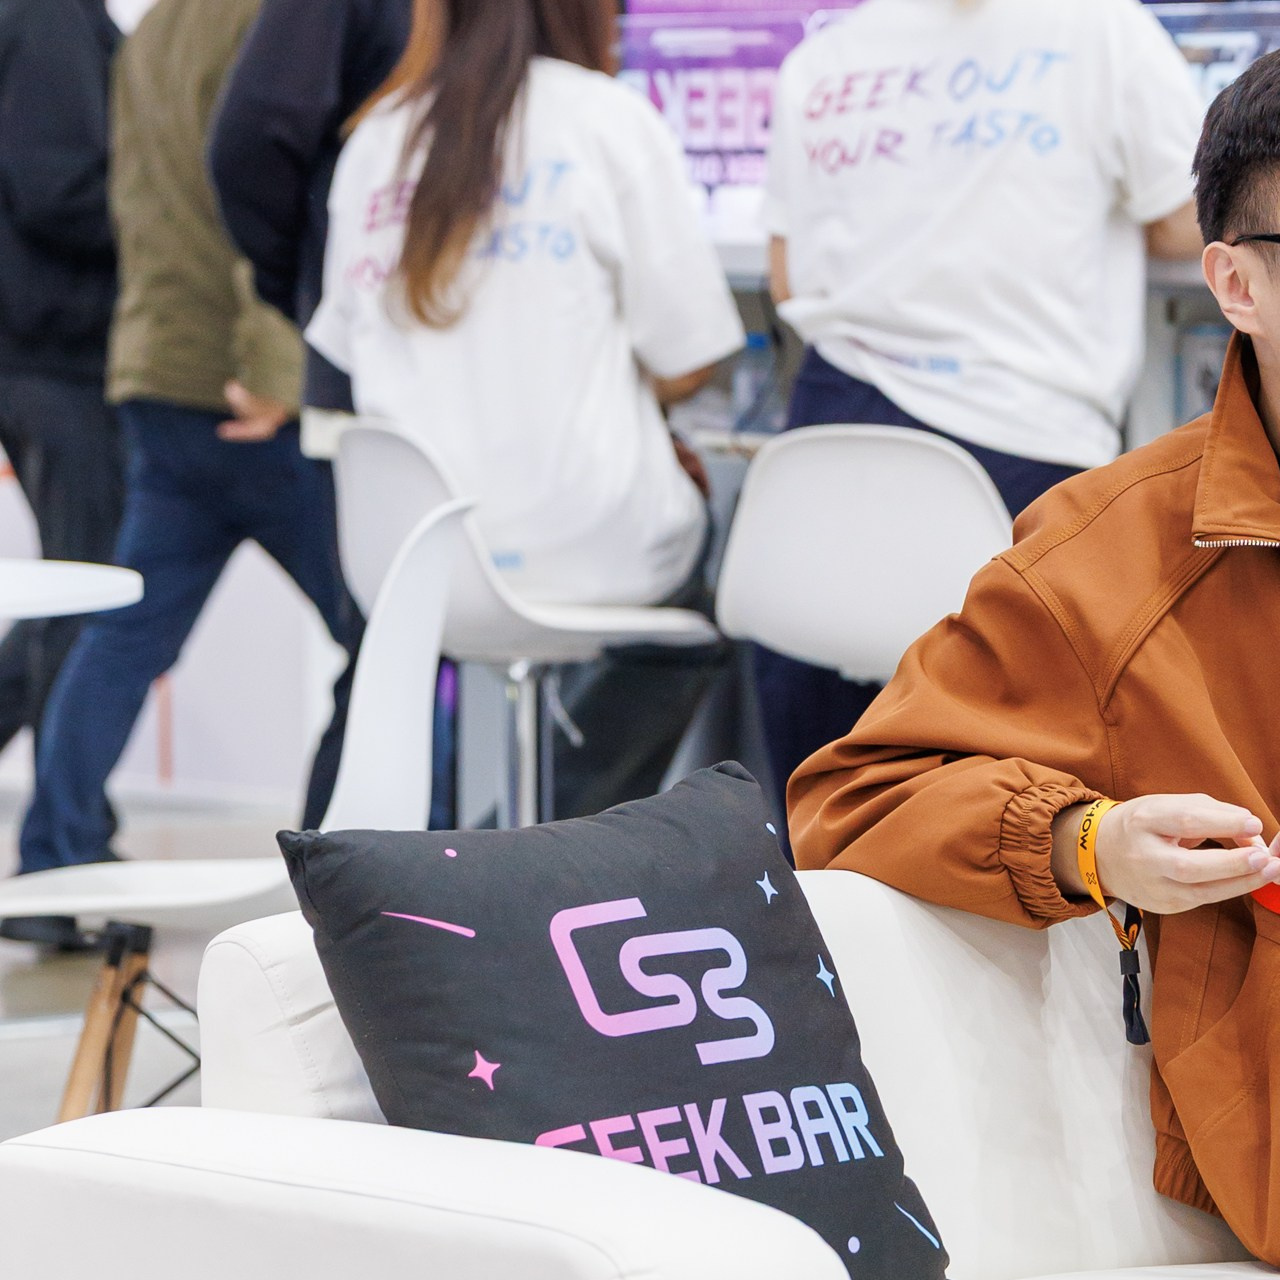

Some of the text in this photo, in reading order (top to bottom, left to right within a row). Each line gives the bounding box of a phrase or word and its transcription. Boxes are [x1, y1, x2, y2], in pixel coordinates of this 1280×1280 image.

[804, 50, 1068, 122] GEEK OUT
[802, 124, 911, 177] YOUR
[500, 160, 573, 207] UT
[741, 1081, 885, 1175] BAR
